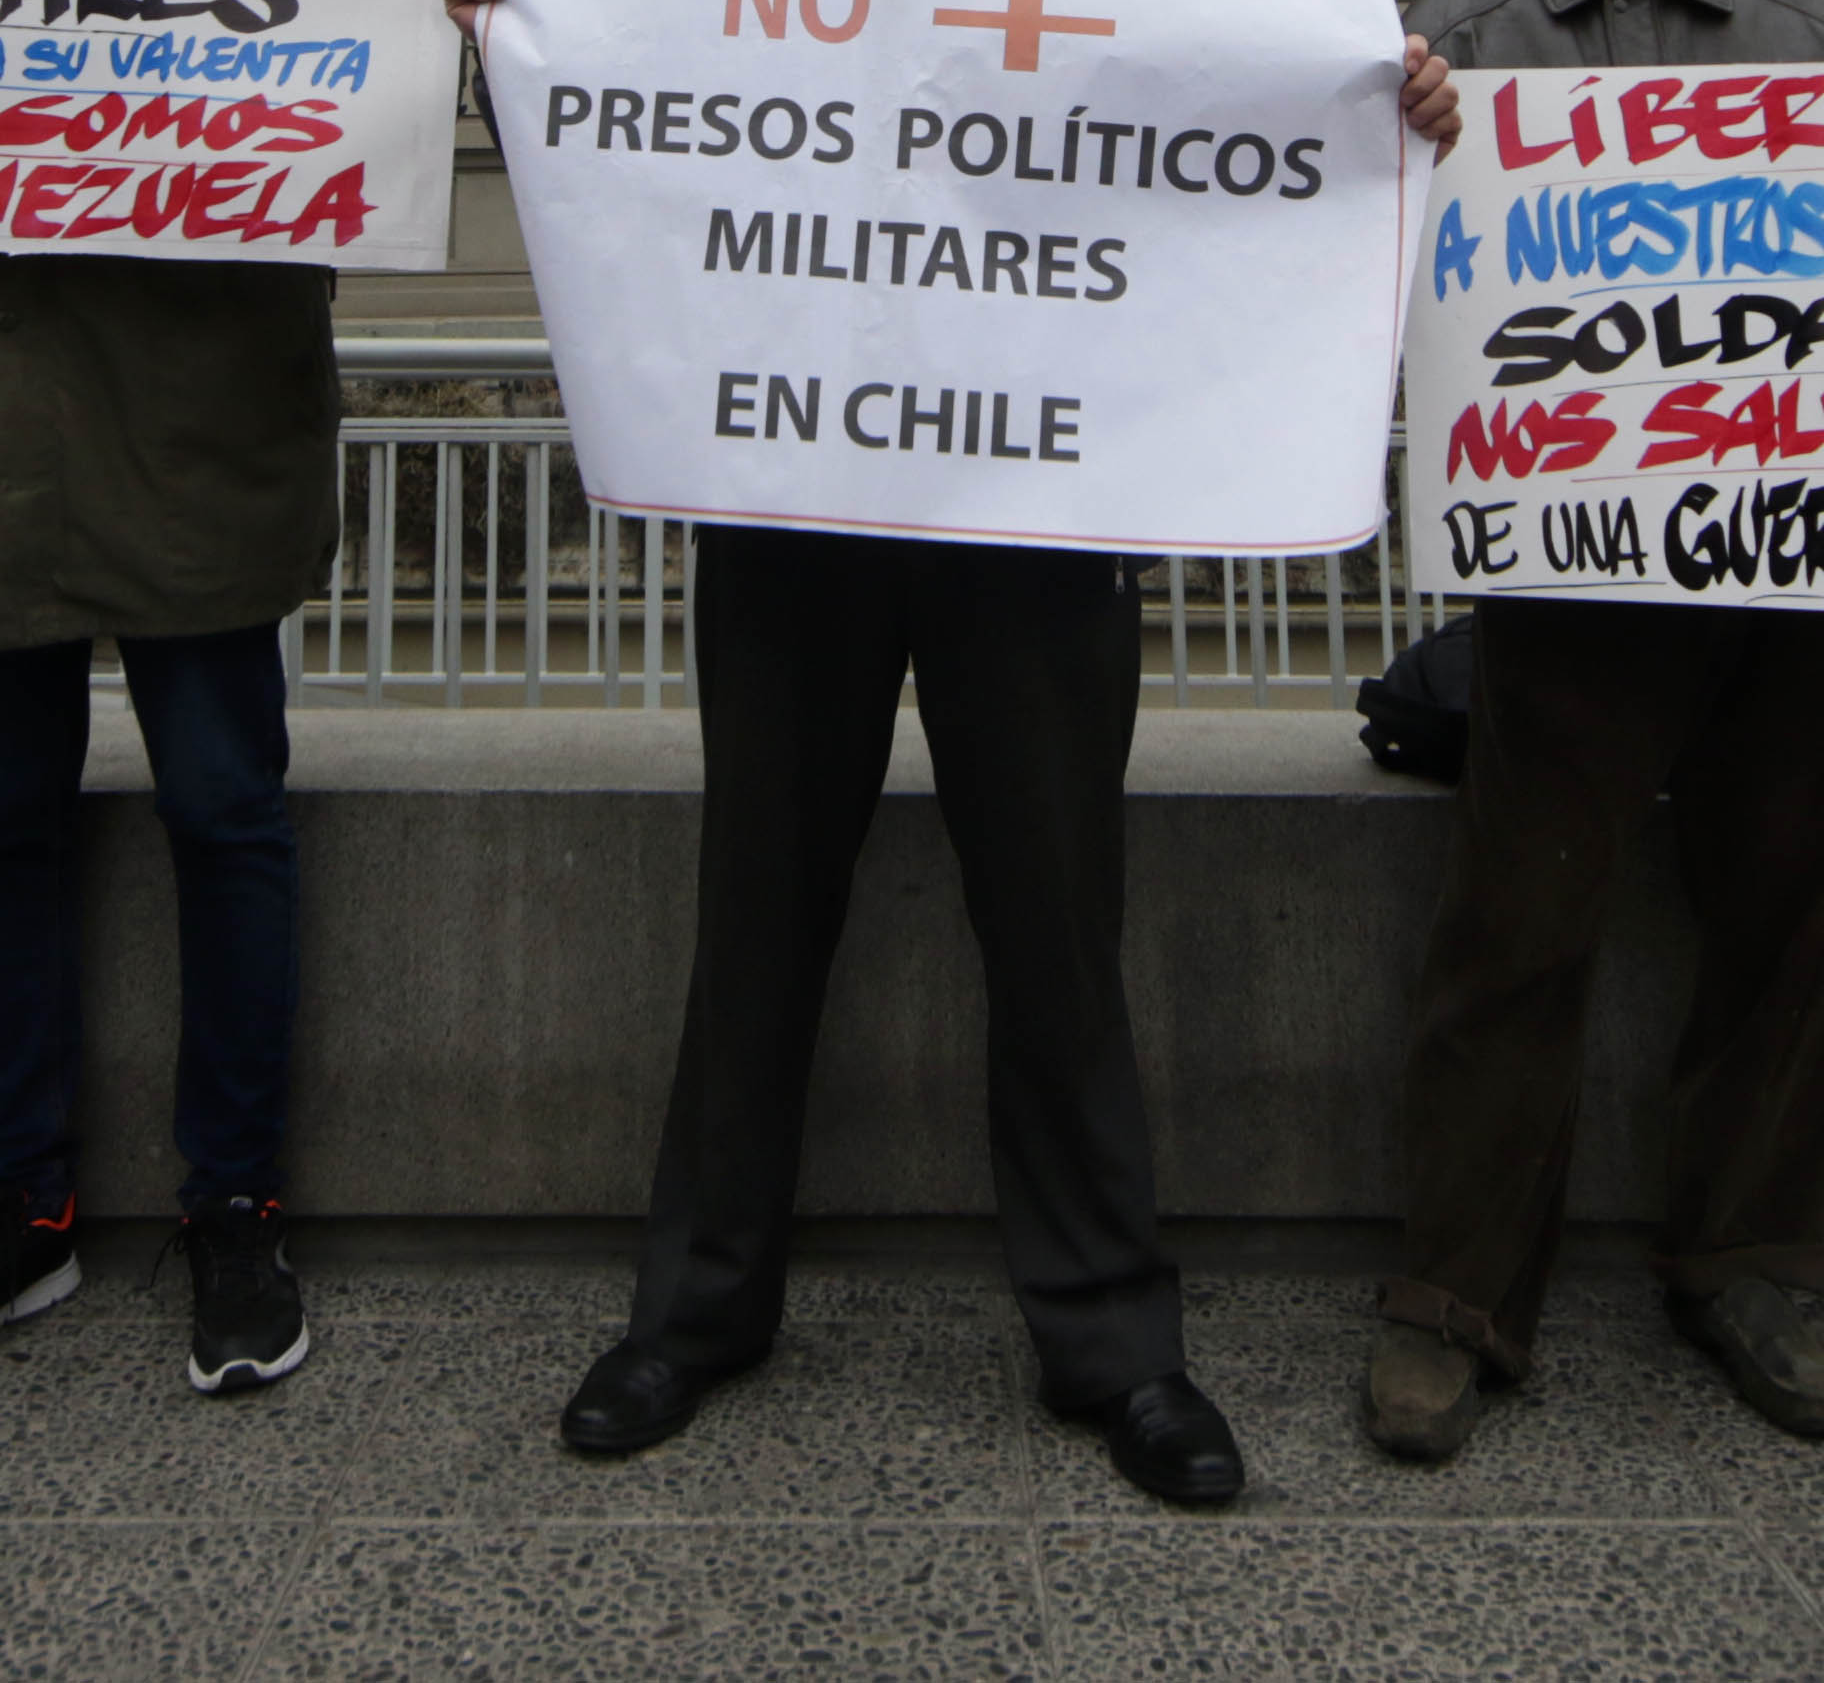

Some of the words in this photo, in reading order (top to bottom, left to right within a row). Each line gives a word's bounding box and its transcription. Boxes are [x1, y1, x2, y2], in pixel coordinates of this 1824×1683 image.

[21, 38, 90, 83] SU
[546, 85, 855, 164] PRESOS
[897, 105, 1325, 200] POLÍTICOS
[704, 208, 1129, 302] MILITARES
[1434, 199, 1483, 303] A
[714, 372, 821, 443] EN
[843, 382, 1081, 464] CHILE
[1446, 391, 1618, 485] NOS
[1443, 499, 1518, 580] DE
[1542, 501, 1648, 576] UNA
